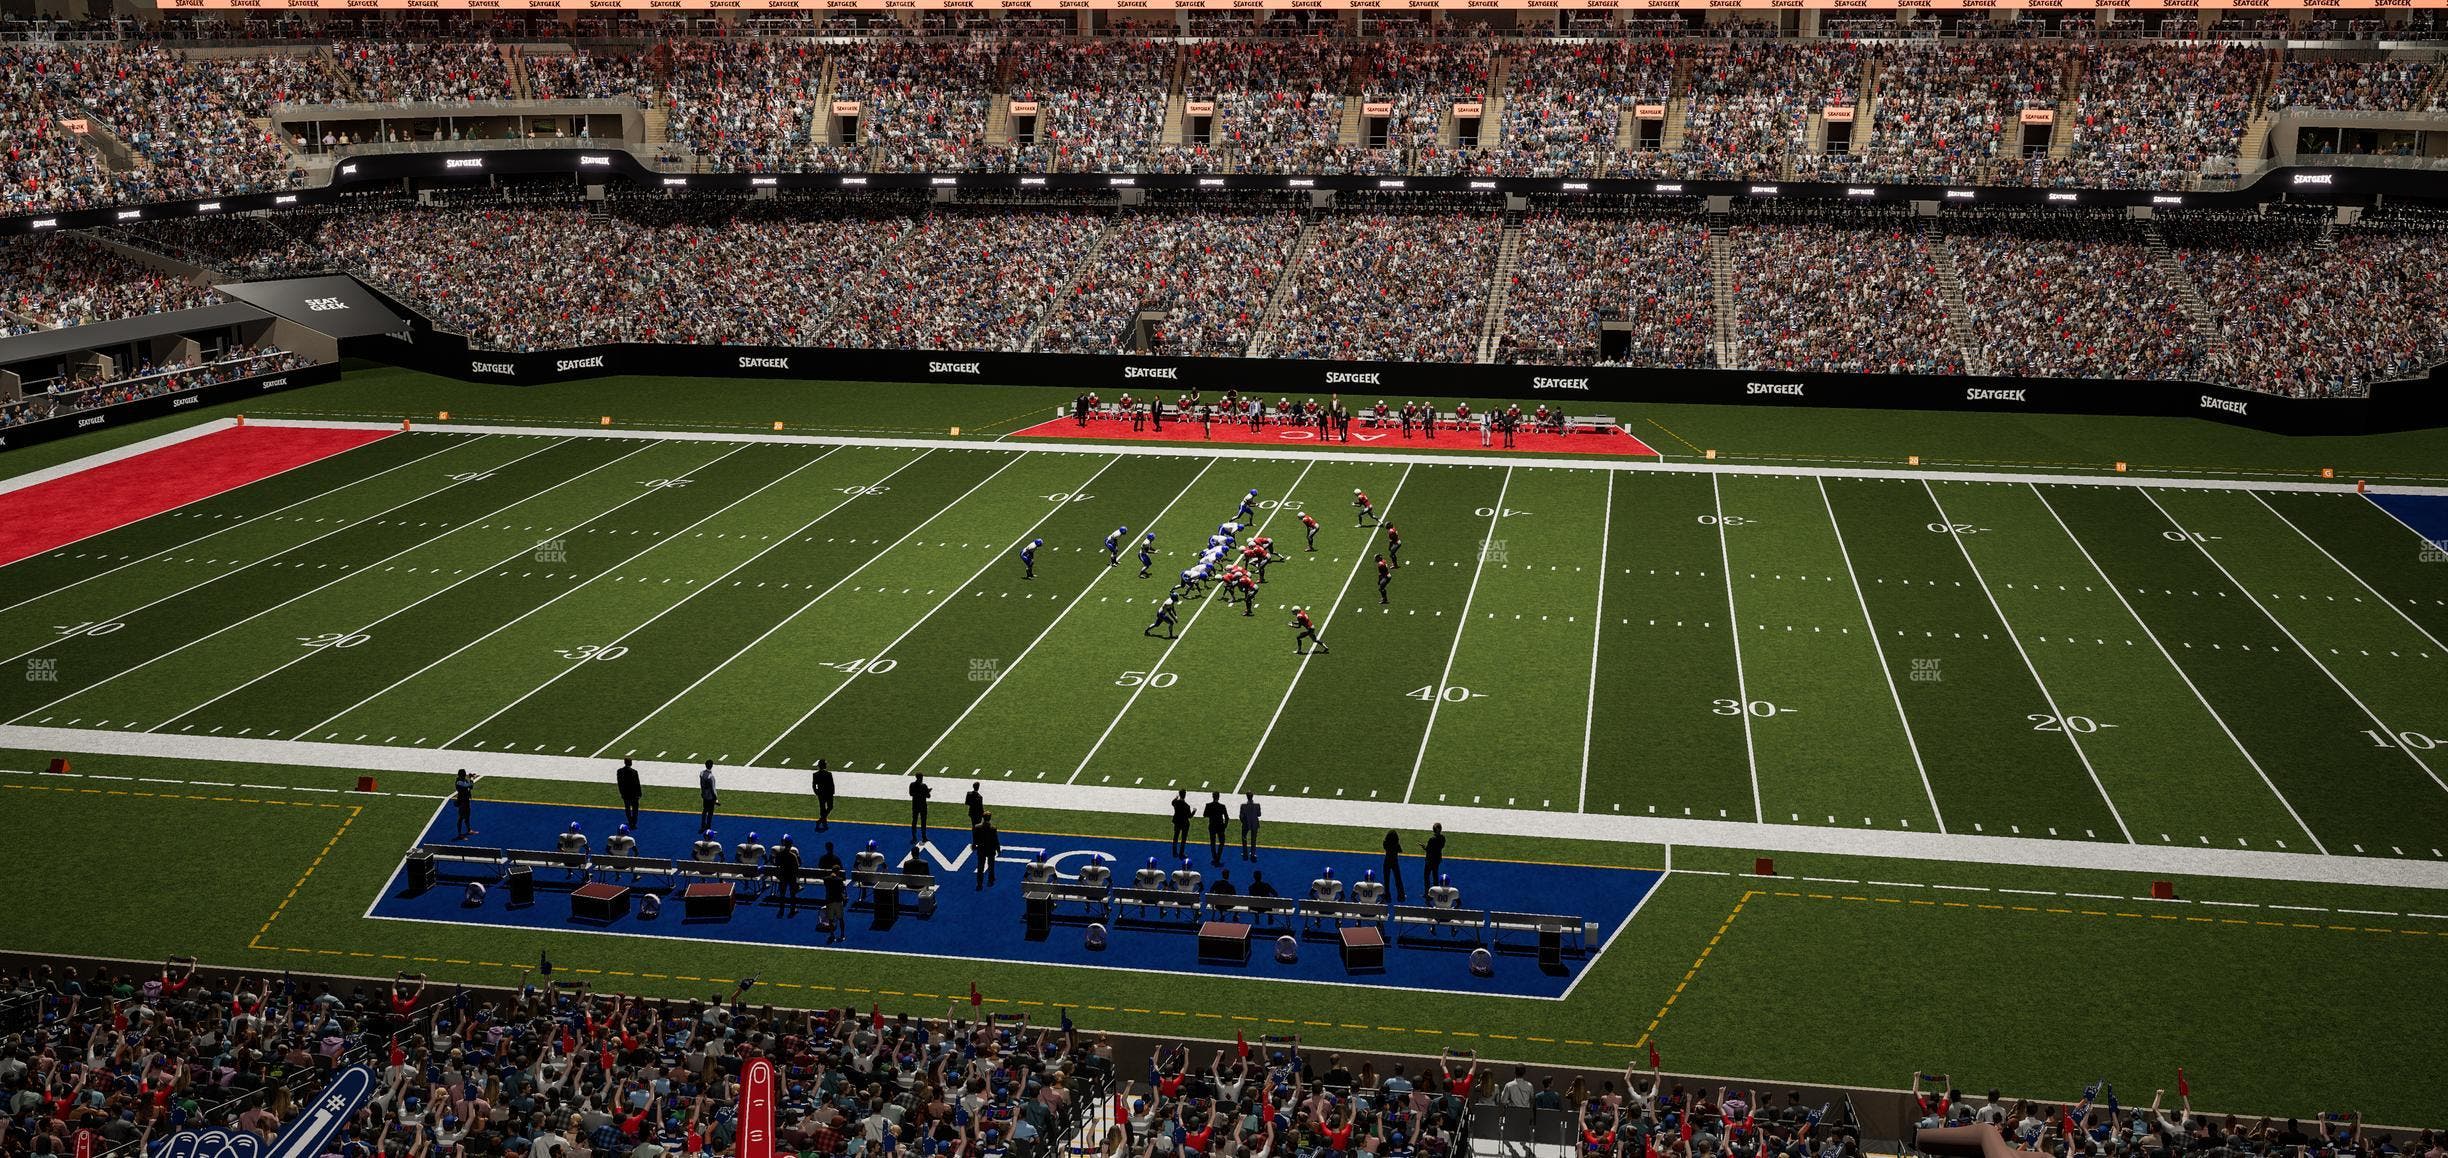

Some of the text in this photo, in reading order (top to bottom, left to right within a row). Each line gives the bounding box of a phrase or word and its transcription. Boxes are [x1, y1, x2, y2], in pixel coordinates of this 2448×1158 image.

[447, 158, 482, 168] SEATGEEK
[581, 156, 609, 166] SEATGEEK
[2293, 175, 2333, 185] SEATGEEK
[305, 297, 338, 306] SEAT
[310, 302, 350, 311] GEEK
[472, 361, 515, 376] SEATGEEK
[557, 355, 604, 372] SEATGEEK
[739, 356, 789, 370] SEATGEEK
[929, 361, 980, 374] SEATGEEK
[1124, 366, 1177, 380] SEATGEEK
[1326, 371, 1380, 386] SEATGEEK
[1533, 376, 1589, 391] SEATGEEK
[1746, 382, 1804, 397] SEATGEEK
[1967, 388, 2026, 402] SEATGEEK
[2200, 395, 2248, 416] SEATGEEK
[896, 841, 1117, 880] NFC
[1321, 887, 1331, 896] 00
[1362, 889, 1373, 898] 00
[1438, 894, 1448, 903] 00
